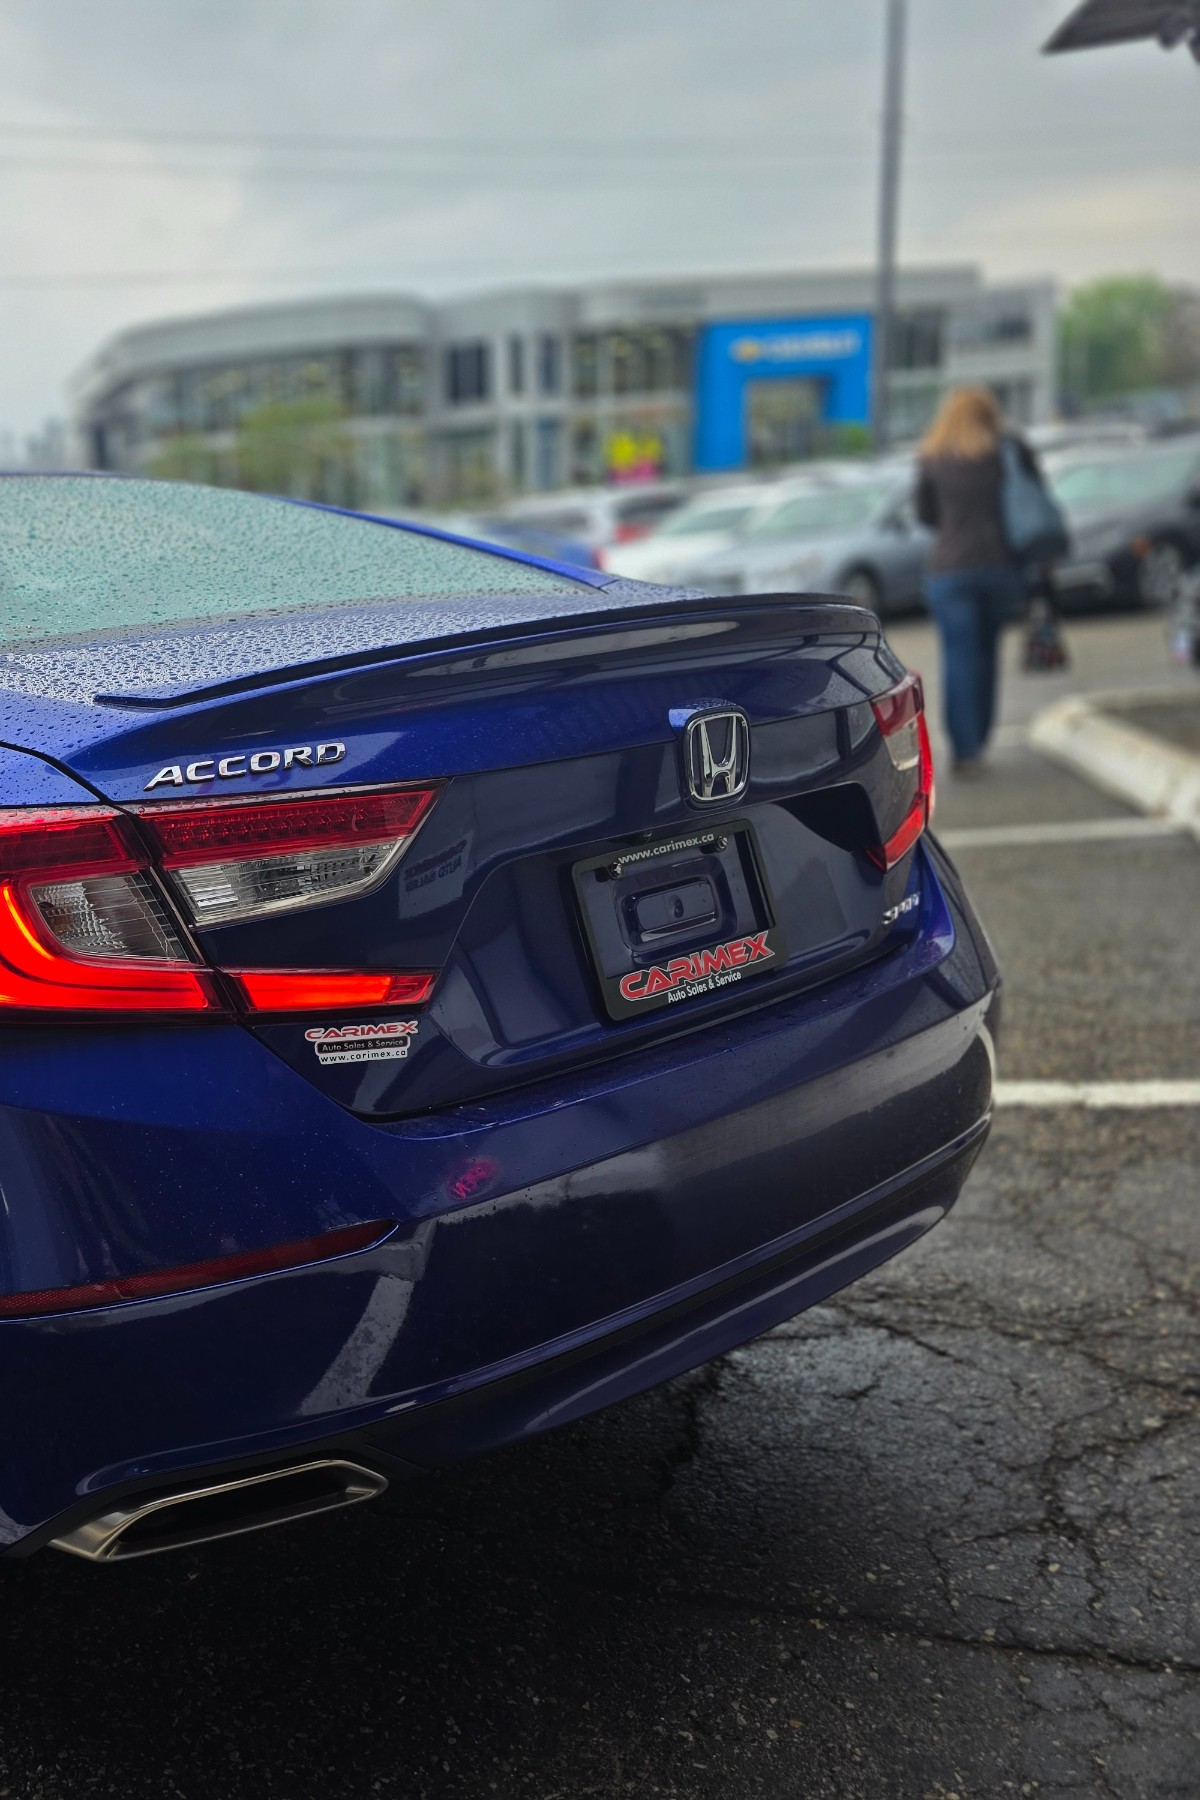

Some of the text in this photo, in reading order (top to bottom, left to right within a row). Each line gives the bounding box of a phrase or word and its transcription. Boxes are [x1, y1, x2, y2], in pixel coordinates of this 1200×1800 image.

[142, 742, 347, 792] ACCORD
[618, 833, 715, 864] www.carimex.ca
[620, 932, 773, 1000] CARIMEX
[667, 970, 742, 1004] Auto Sales & Service
[305, 1021, 418, 1040] CARIMEX
[322, 1038, 405, 1052] Auto Sales & Service
[320, 1049, 406, 1063] www.carimex.ca
